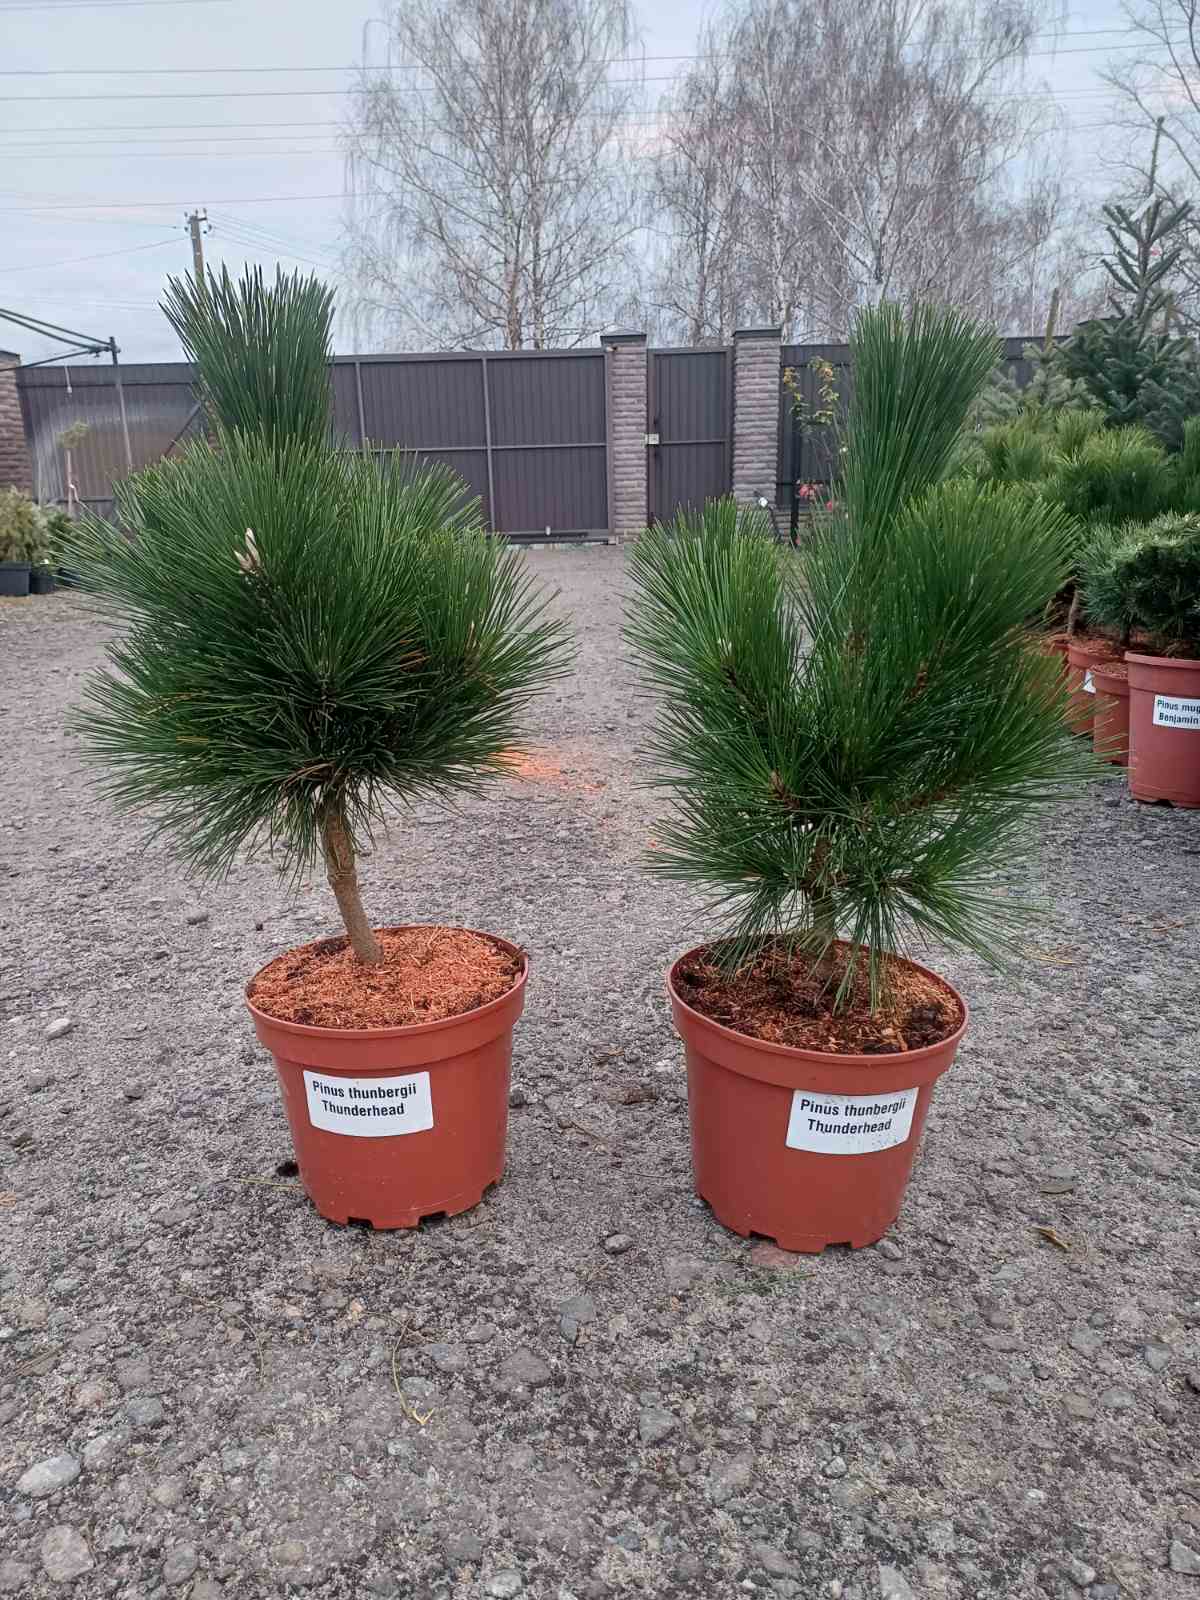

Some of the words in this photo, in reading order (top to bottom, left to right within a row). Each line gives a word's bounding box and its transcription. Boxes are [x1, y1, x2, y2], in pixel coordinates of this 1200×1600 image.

[1157, 699, 1179, 711] Pinus
[312, 1080, 345, 1098] Pinus
[349, 1083, 417, 1099] thunbergii
[321, 1100, 405, 1117] Thunderhead
[800, 1099, 840, 1116] Pinus
[845, 1098, 906, 1117] thunbergii
[807, 1118, 893, 1134] Thunderhead
